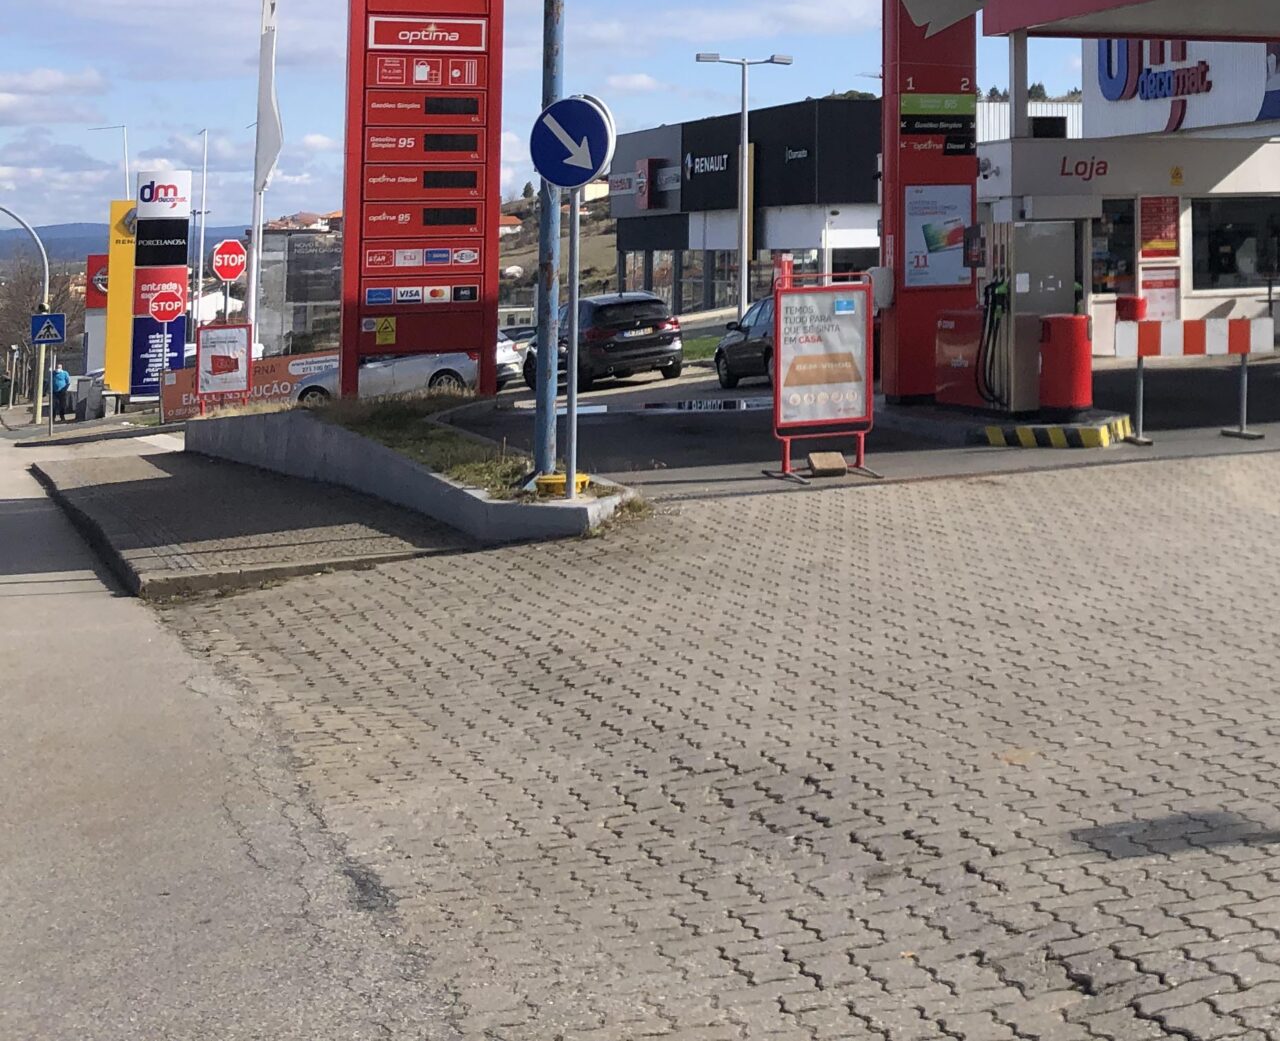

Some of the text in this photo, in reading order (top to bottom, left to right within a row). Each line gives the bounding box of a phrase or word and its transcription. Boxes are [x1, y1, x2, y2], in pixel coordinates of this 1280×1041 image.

[398, 28, 460, 44] optima
[906, 76, 915, 91] 1
[960, 77, 970, 91] 2
[398, 137, 415, 148] 95
[694, 154, 729, 173] RENAULT
[1060, 156, 1109, 181] Loja
[138, 238, 187, 246] PORCELANOSA
[215, 254, 246, 267] STOP
[400, 289, 420, 298] VISA
[151, 301, 182, 311] STOP
